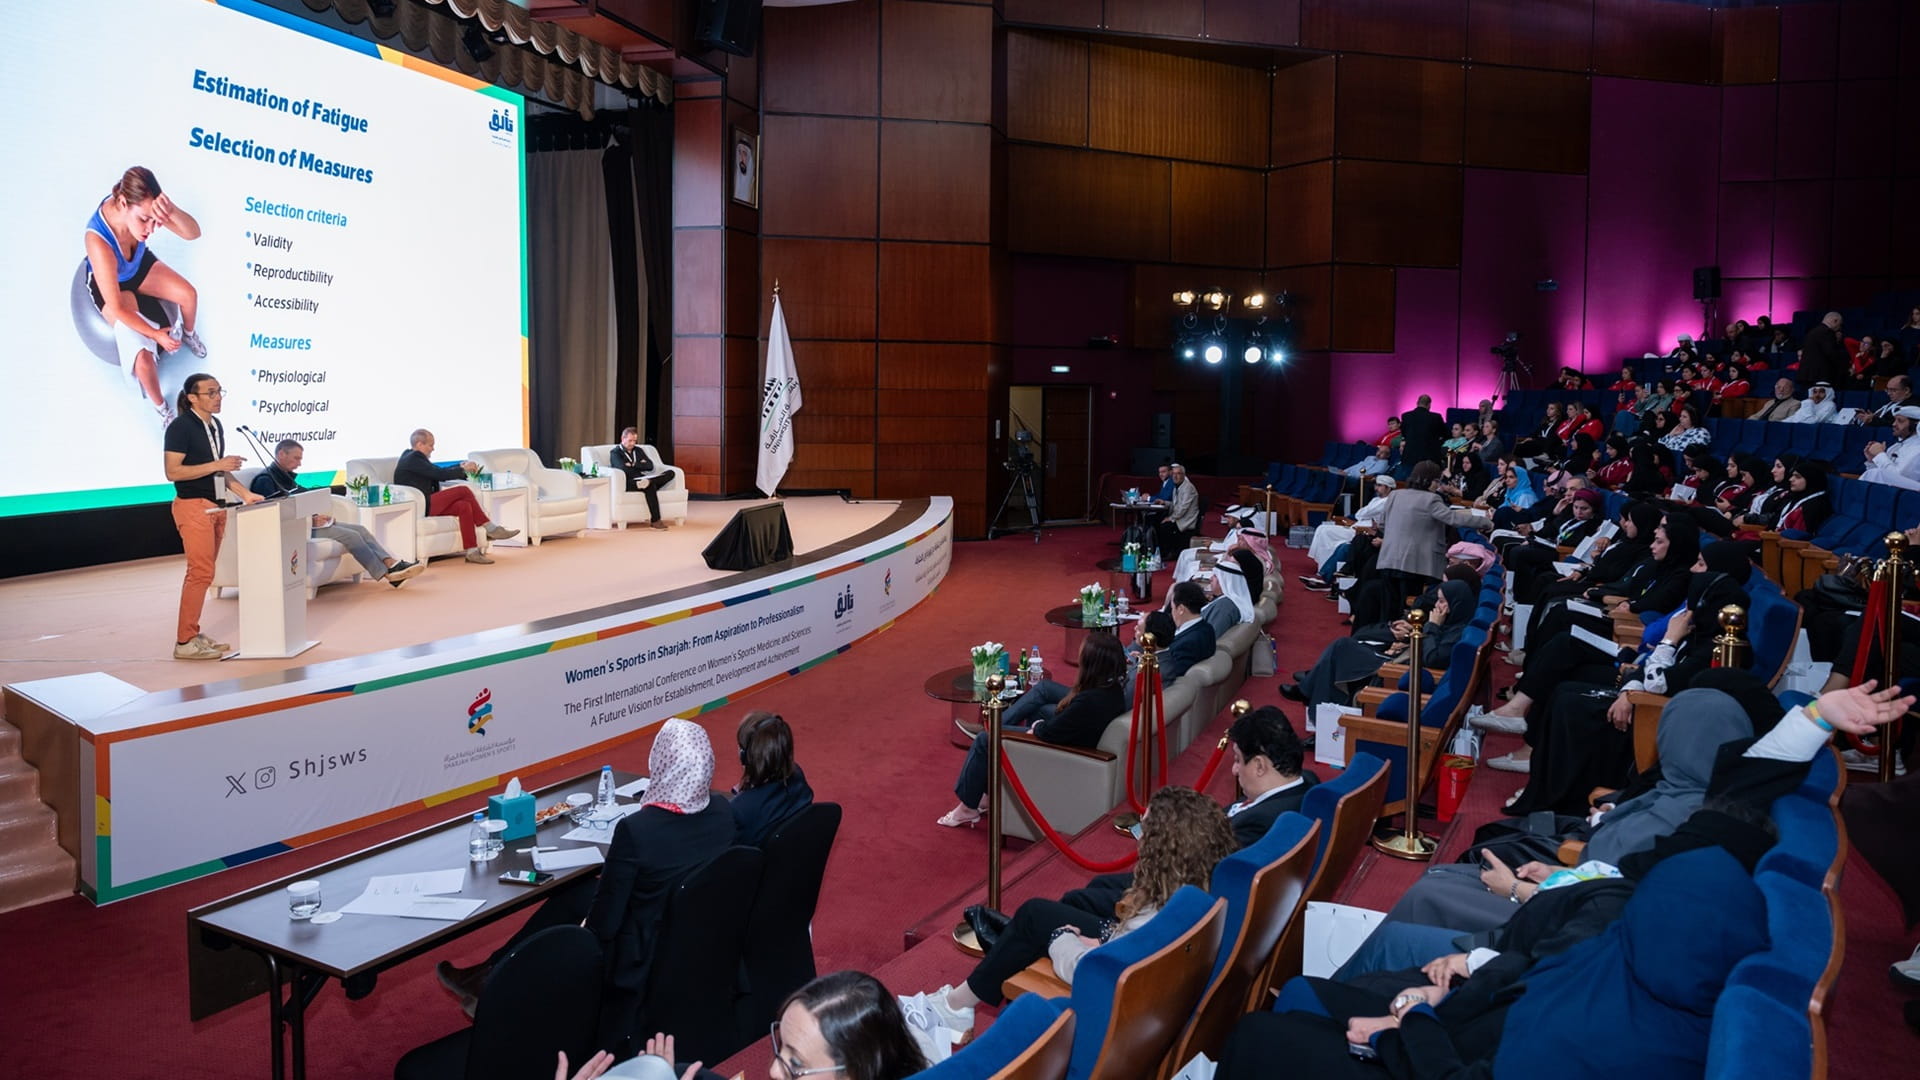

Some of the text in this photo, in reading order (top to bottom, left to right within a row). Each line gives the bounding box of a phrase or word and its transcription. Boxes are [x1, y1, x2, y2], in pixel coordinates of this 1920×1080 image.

[193, 69, 368, 133] Estimation of Fatigue
[189, 127, 373, 184] Selection of Measures
[245, 196, 347, 227] Selection criteria
[253, 232, 293, 252] Validity
[253, 263, 333, 286] Reproductibility
[254, 295, 319, 314] Accessibility
[250, 333, 312, 350] Measures
[258, 369, 326, 386] Physiological
[258, 399, 329, 415] Psychological
[259, 429, 337, 443] Neuromuscular
[565, 605, 805, 684] Women's Sports in Sharjah: From Aspiration to Professionalism
[564, 702, 581, 715] The
[583, 694, 603, 710] First
[605, 680, 654, 704] International
[656, 665, 697, 687] Conference
[697, 663, 707, 673] on
[707, 651, 737, 670] Women's
[737, 646, 756, 661] Sports
[756, 637, 781, 652] Medicine
[781, 632, 791, 644] and
[590, 645, 800, 728] A Future Vision for Establishment, Development and Achievement
[288, 748, 368, 780] Shjsws
